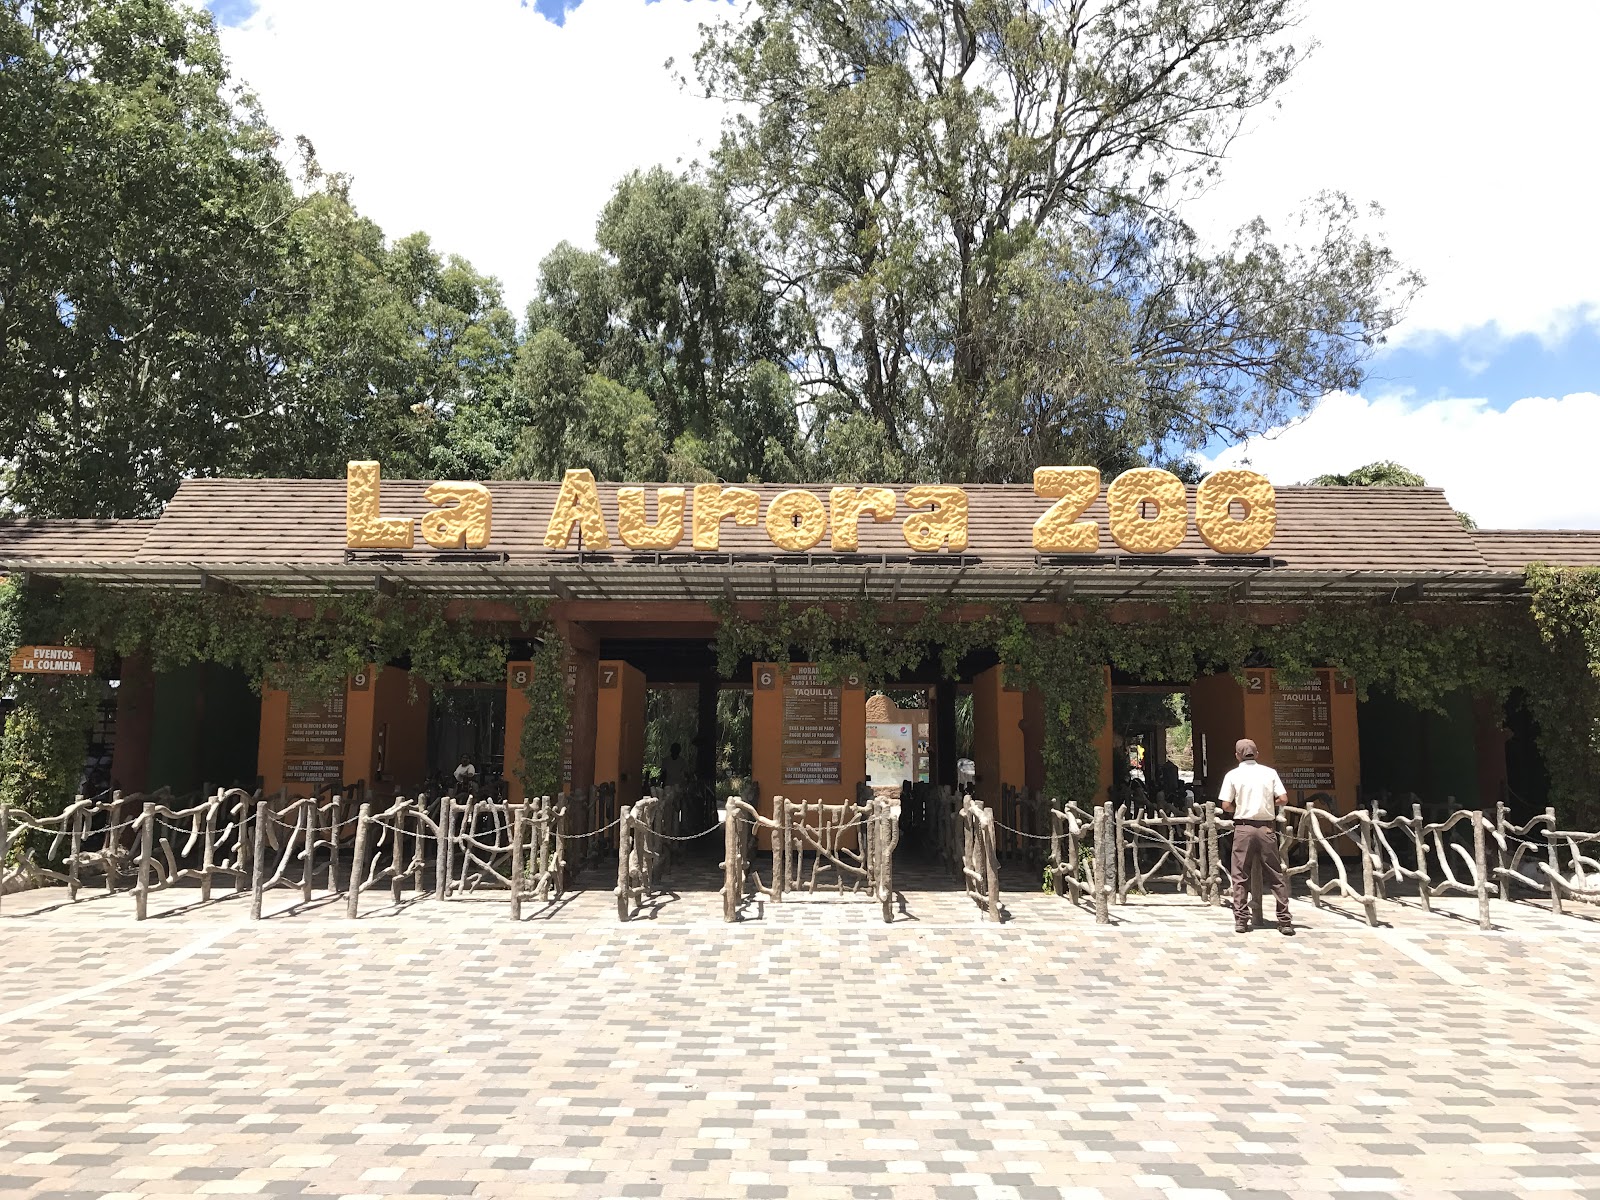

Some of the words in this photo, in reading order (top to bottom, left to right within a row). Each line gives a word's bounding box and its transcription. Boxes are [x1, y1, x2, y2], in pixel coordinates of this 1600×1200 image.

[347, 460, 492, 549] La
[543, 468, 969, 552] Aurora
[33, 649, 74, 659] EVENTOS
[22, 660, 34, 669] LA
[37, 661, 82, 671] COLMENA
[355, 674, 366, 686] 9
[516, 671, 527, 684] 8
[604, 671, 614, 684] 7
[760, 673, 772, 685] 6
[848, 673, 859, 685] 5
[1250, 677, 1262, 690] 2
[793, 688, 833, 697] TAQUILLA
